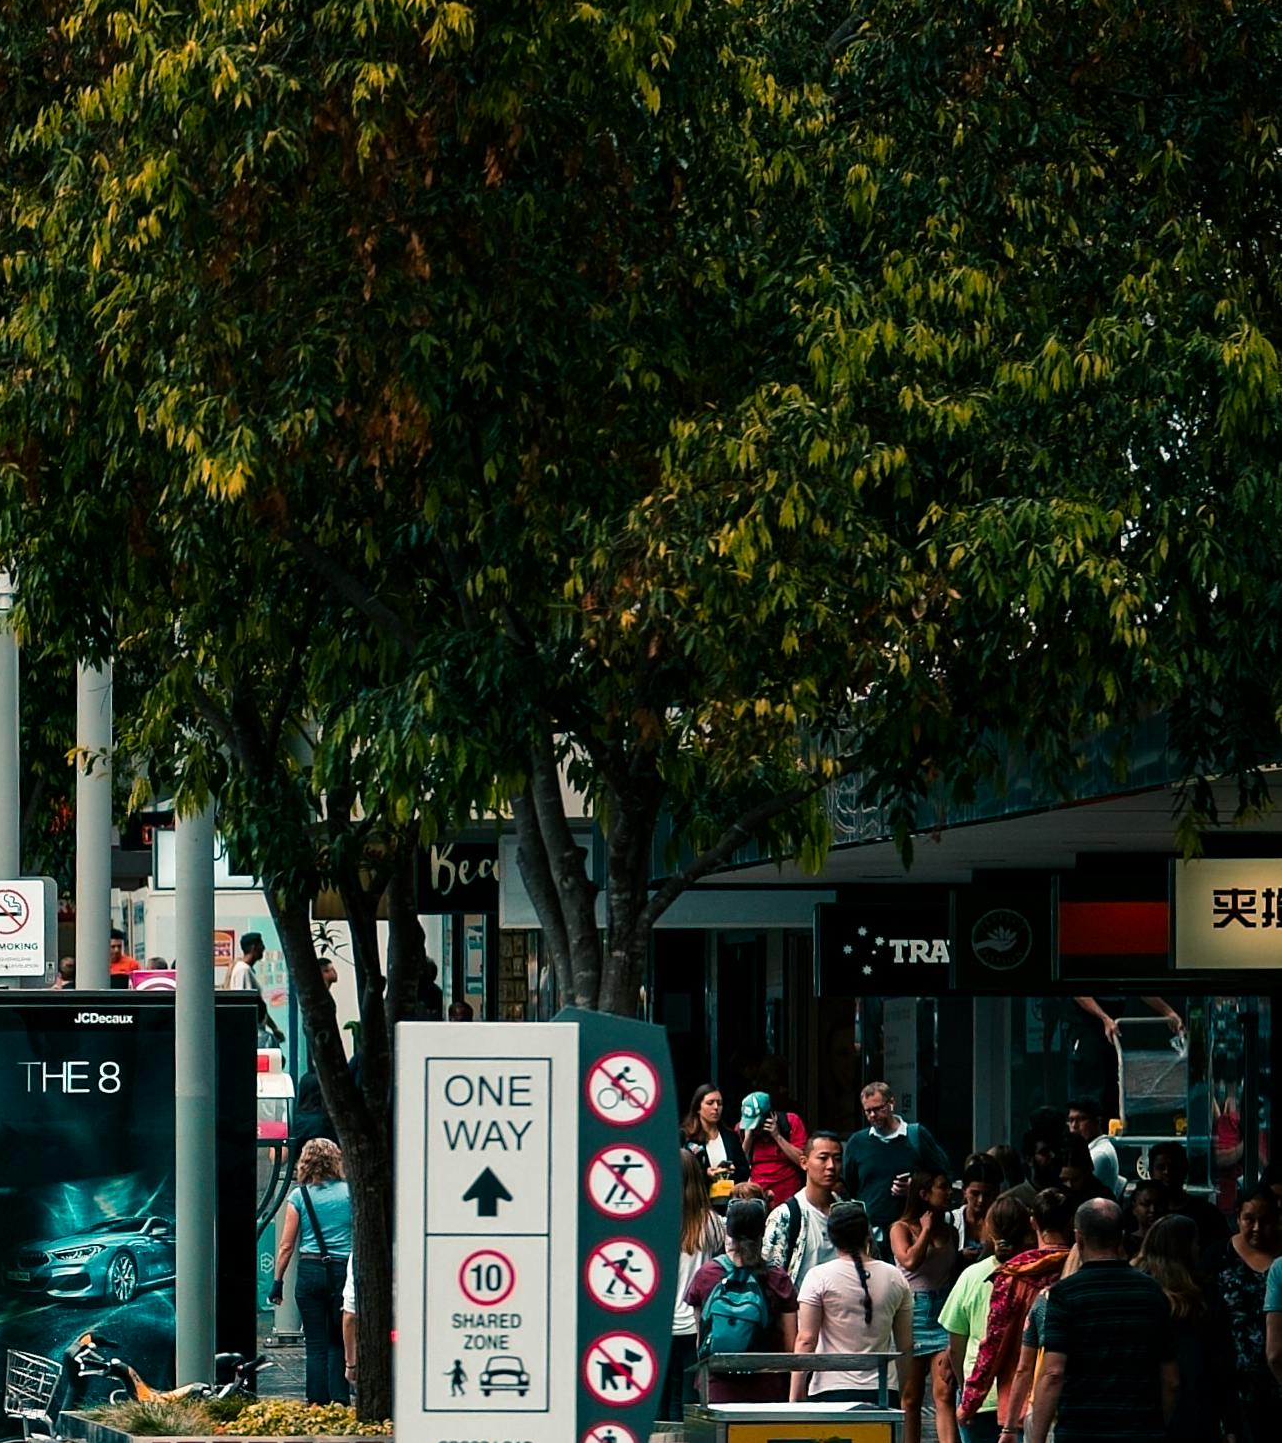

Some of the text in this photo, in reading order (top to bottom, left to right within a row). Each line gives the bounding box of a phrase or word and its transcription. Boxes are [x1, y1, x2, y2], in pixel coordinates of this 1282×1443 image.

[889, 939, 950, 964] TRA
[74, 1012, 134, 1024] JCDecaux
[17, 1061, 121, 1094] THE 8
[444, 1074, 533, 1107] ONE
[443, 1120, 533, 1151] WAY
[470, 1264, 502, 1292] 10
[451, 1313, 522, 1329] SHARED
[463, 1334, 510, 1350] ZONE
